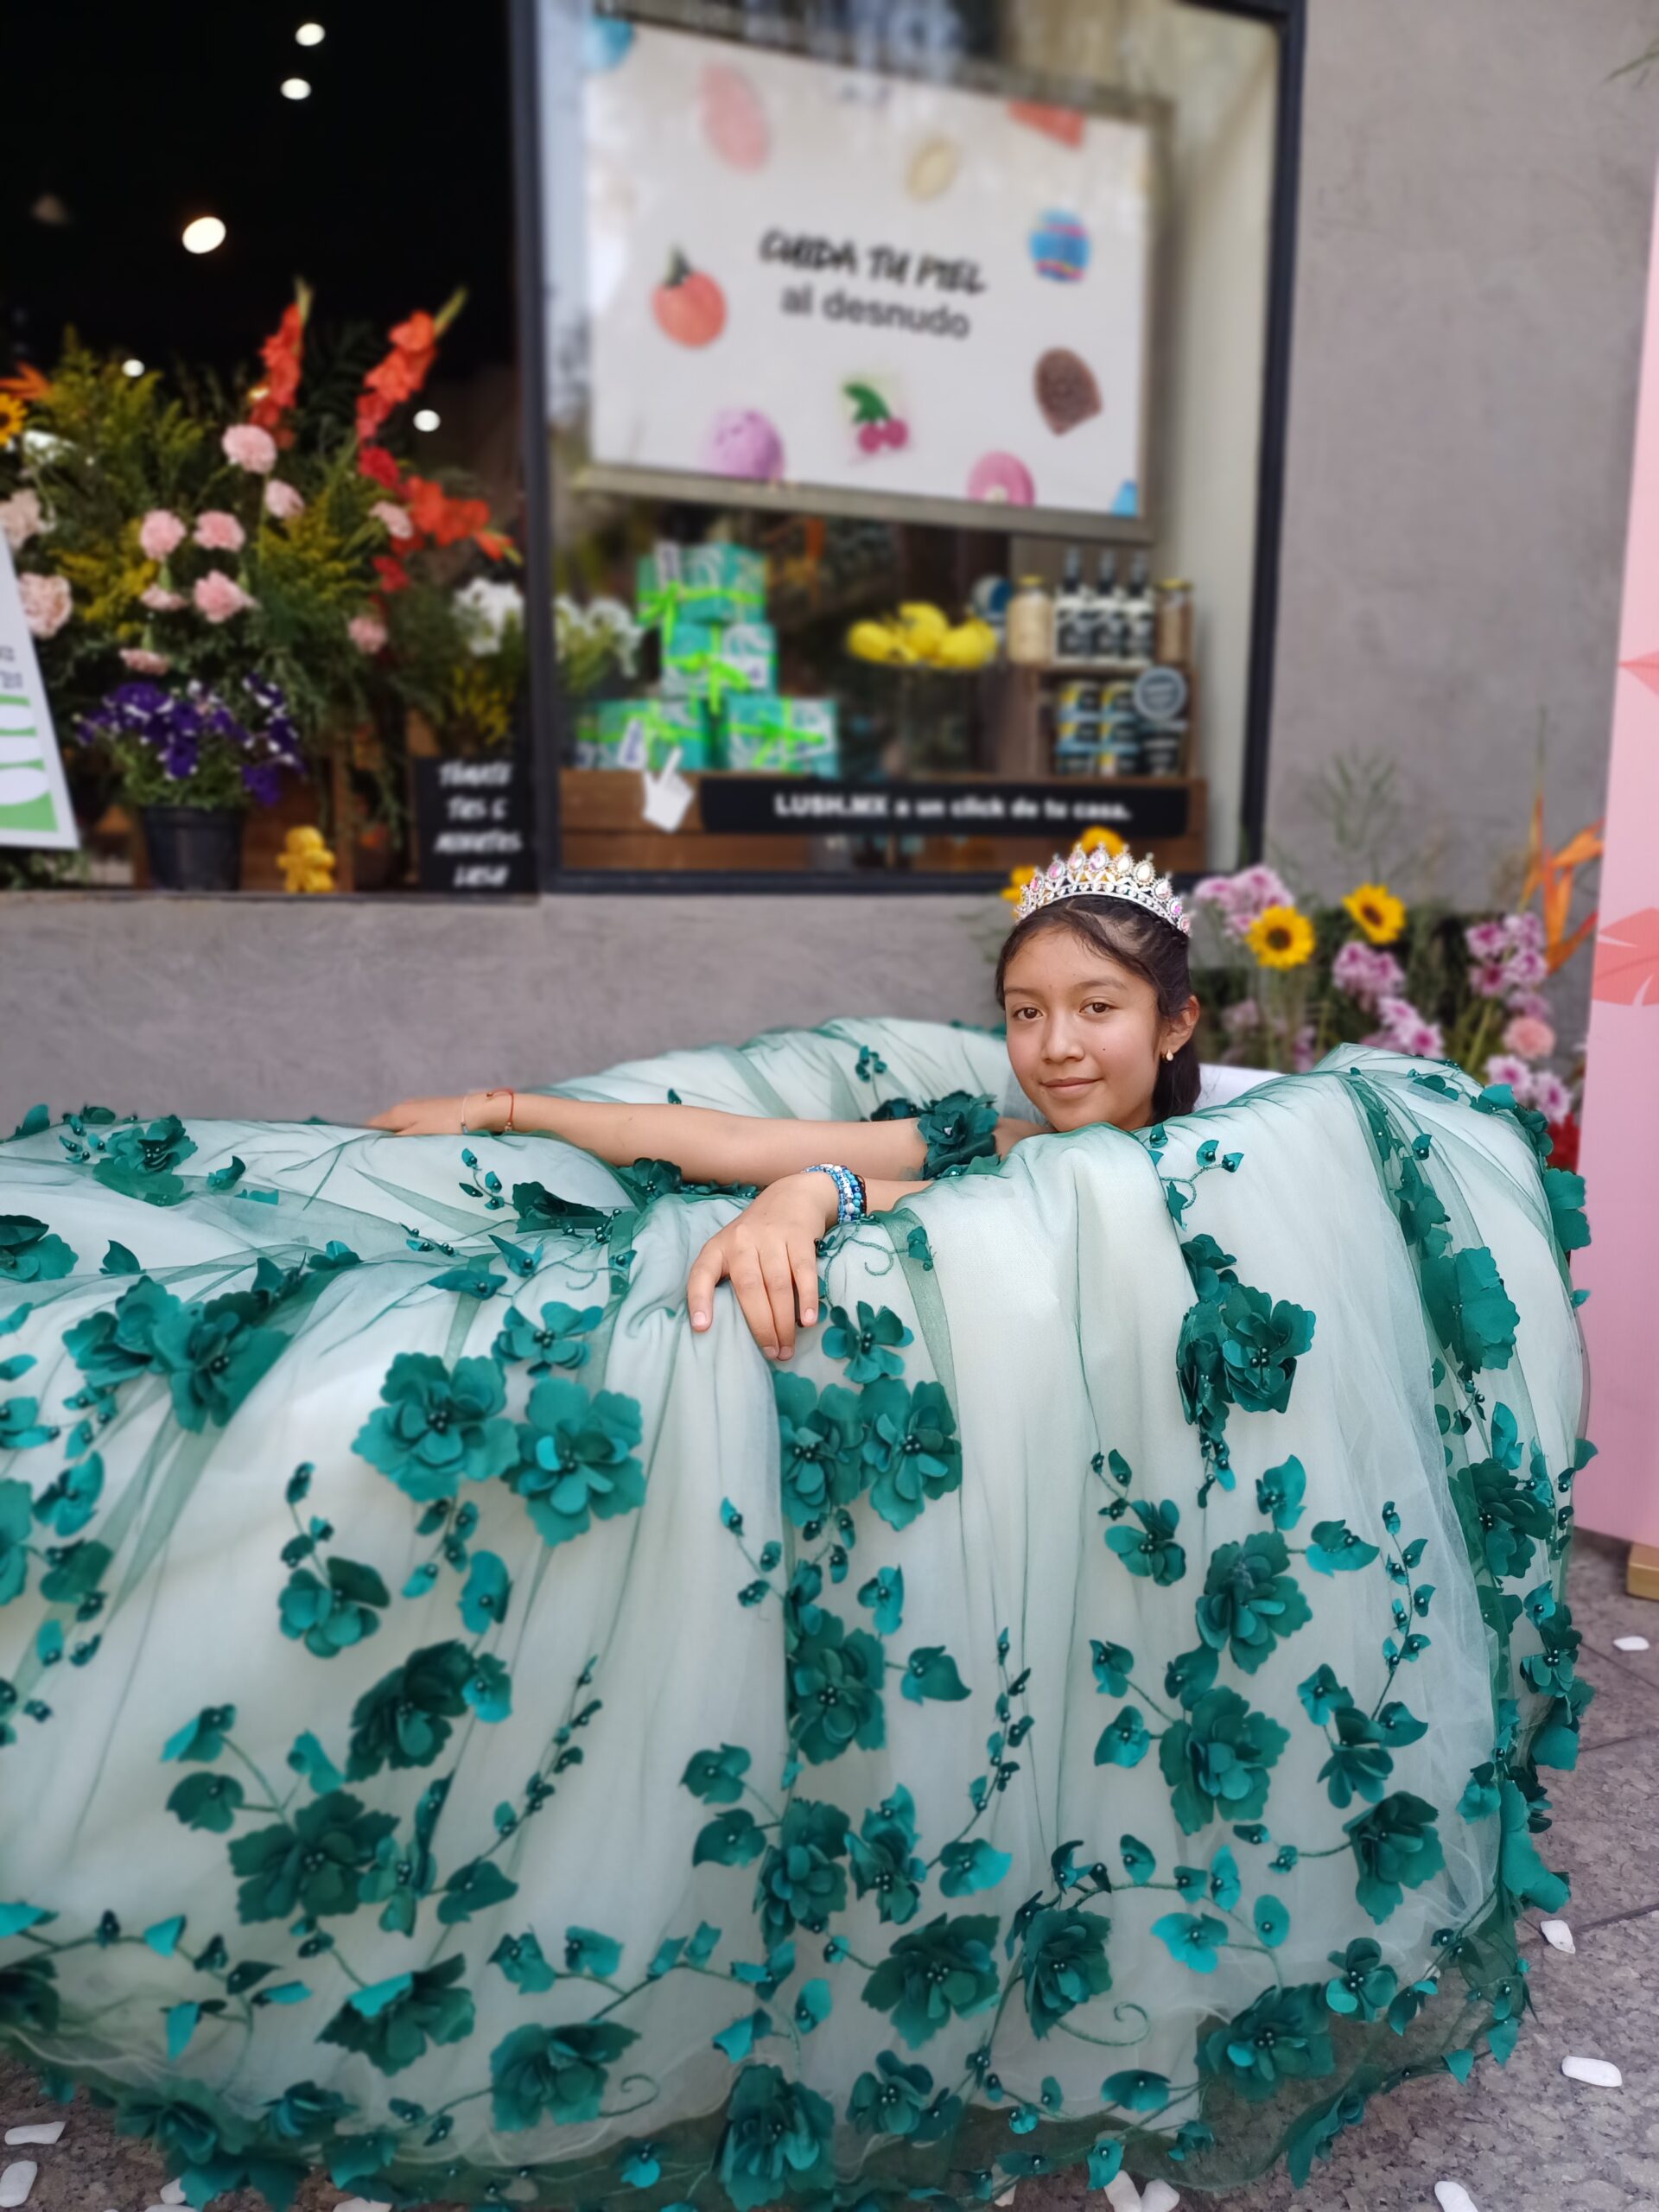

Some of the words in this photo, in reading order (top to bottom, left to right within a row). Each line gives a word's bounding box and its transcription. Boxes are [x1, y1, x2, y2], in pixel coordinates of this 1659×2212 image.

[759, 229, 858, 275] CUIDA
[868, 245, 912, 285] TU
[914, 255, 986, 296] PIEL
[781, 286, 814, 315] al
[822, 287, 970, 340] desnudo
[774, 793, 888, 817] LUSH.MX
[914, 799, 946, 818] un
[950, 796, 1005, 818] click
[1010, 798, 1040, 818] de
[1043, 799, 1068, 819] tu
